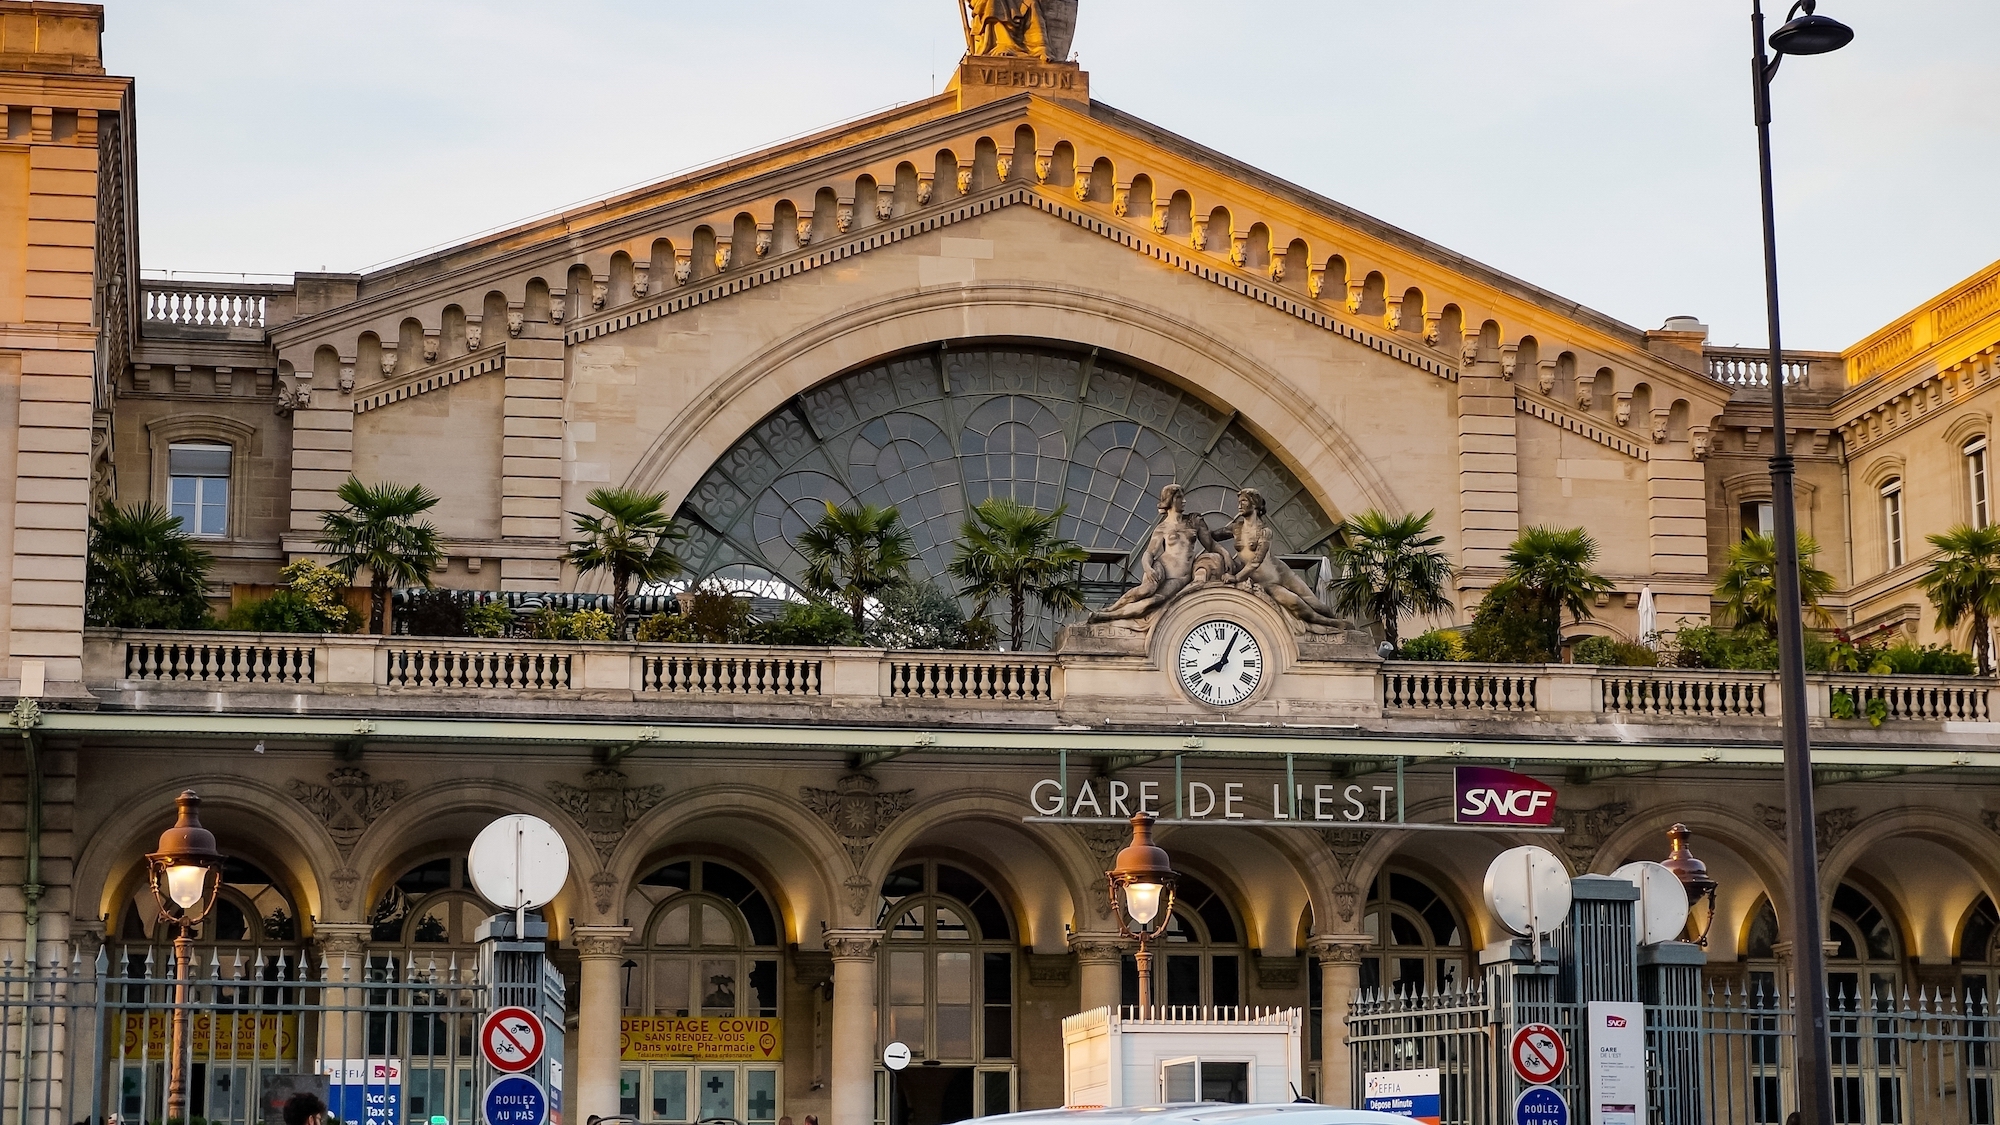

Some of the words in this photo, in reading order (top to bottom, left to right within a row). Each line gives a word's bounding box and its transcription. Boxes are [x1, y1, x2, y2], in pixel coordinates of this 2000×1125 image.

[978, 68, 1073, 90] VERDUN
[1029, 779, 1161, 818] GARE
[1189, 781, 1245, 819] DE
[1272, 783, 1395, 822] L'EST
[1461, 788, 1553, 816] SNCF
[620, 1020, 709, 1032] DEPISTAGE
[719, 1020, 769, 1033] COVID
[1607, 1019, 1626, 1027] SNCF
[644, 1033, 672, 1042] SANS
[675, 1033, 745, 1042] RENDEZ-VOUS
[634, 1042, 661, 1052] Dans
[665, 1042, 693, 1052] votre
[697, 1042, 755, 1052] Pharmacie
[375, 1069, 398, 1078] SNF
[1379, 1083, 1401, 1093] EFFIA
[366, 1093, 396, 1104] Accs
[495, 1095, 536, 1105] ROULEZ
[1370, 1100, 1391, 1111] Dépose
[1392, 1098, 1413, 1108] Minute
[1524, 1104, 1560, 1114] ROULEZ
[366, 1106, 394, 1117] Taxs
[496, 1110, 510, 1121] AU
[515, 1110, 535, 1121] PAS
